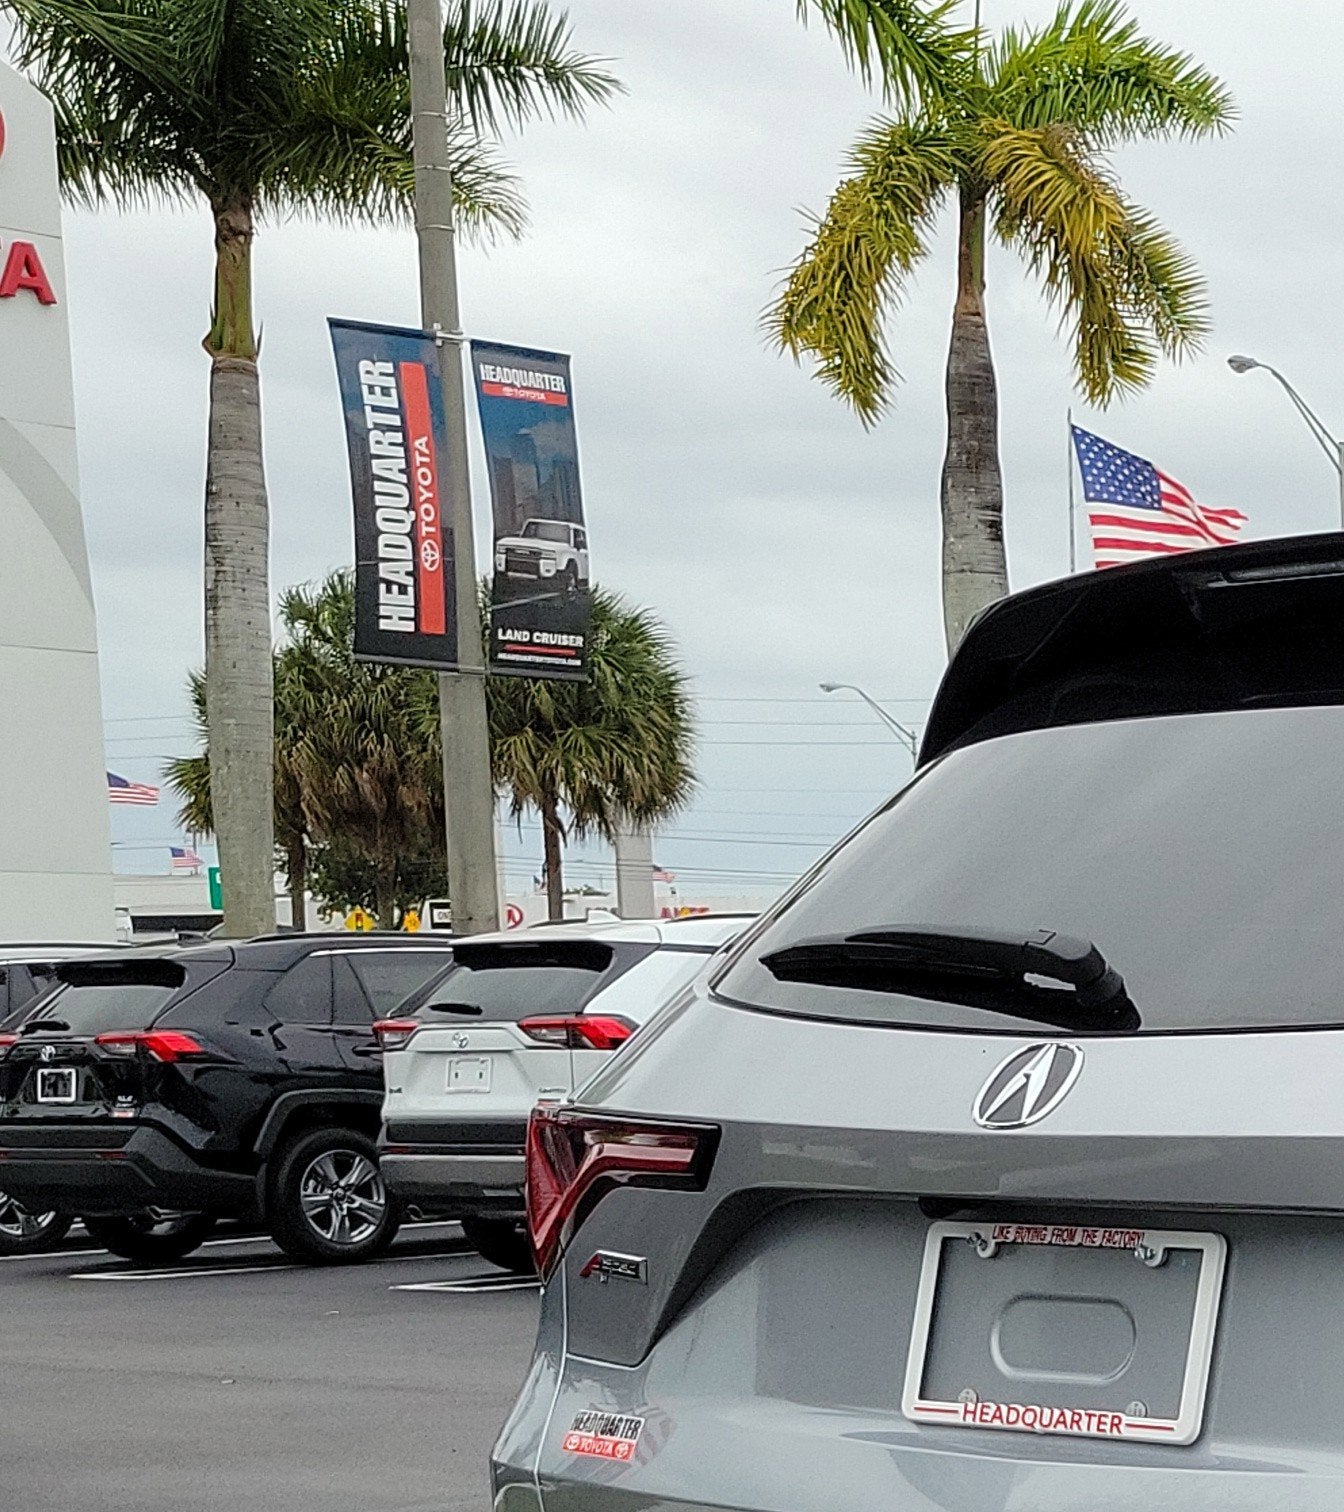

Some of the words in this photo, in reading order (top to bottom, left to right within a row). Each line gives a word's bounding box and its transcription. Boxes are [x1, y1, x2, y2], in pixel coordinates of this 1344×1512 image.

[479, 363, 566, 392] HEADQUARTER
[358, 358, 416, 633] HEADQUARTER
[414, 436, 438, 537] TOYOTA
[497, 627, 530, 642] LAND
[533, 631, 584, 647] CRUISER
[962, 1402, 1124, 1434] HEADQUARTER
[578, 1437, 613, 1456] TOYOTA
